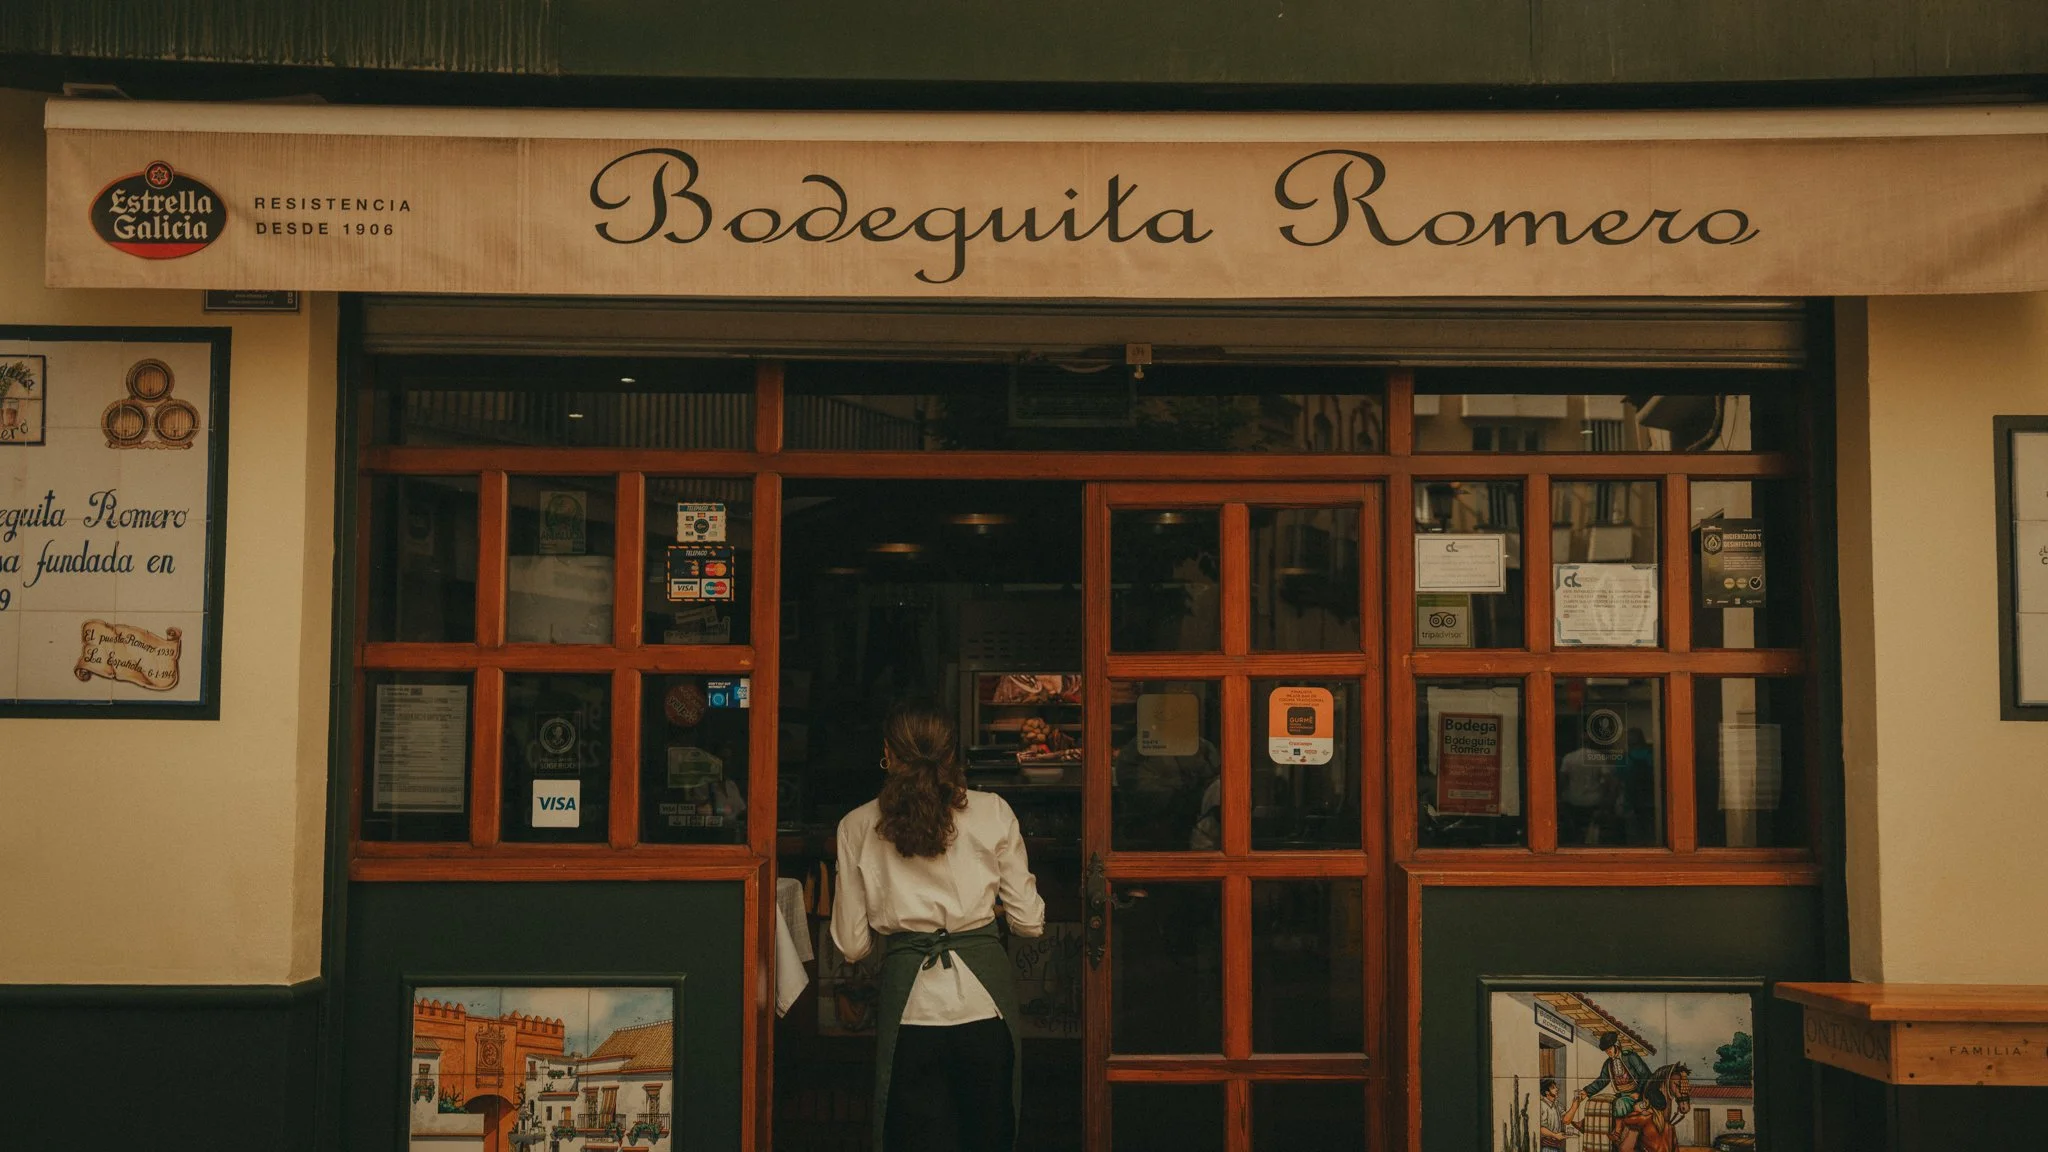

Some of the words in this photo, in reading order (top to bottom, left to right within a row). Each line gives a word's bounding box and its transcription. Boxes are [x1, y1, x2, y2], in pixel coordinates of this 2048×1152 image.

[108, 188, 214, 215] Estrella
[254, 197, 412, 213] RESISTENCIA
[589, 147, 1214, 285] Bodeguita
[1274, 148, 1761, 247] Romero
[113, 213, 210, 241] Galicia
[256, 222, 329, 236] DESDE
[343, 222, 394, 236] 1906
[83, 488, 190, 529] Romero
[23, 539, 135, 589] fundada
[146, 554, 176, 574] en
[1445, 718, 1497, 734] Bodega
[1450, 744, 1491, 755] Romero
[537, 797, 577, 811] VISA
[1949, 1046, 2022, 1056] FAMILIA
